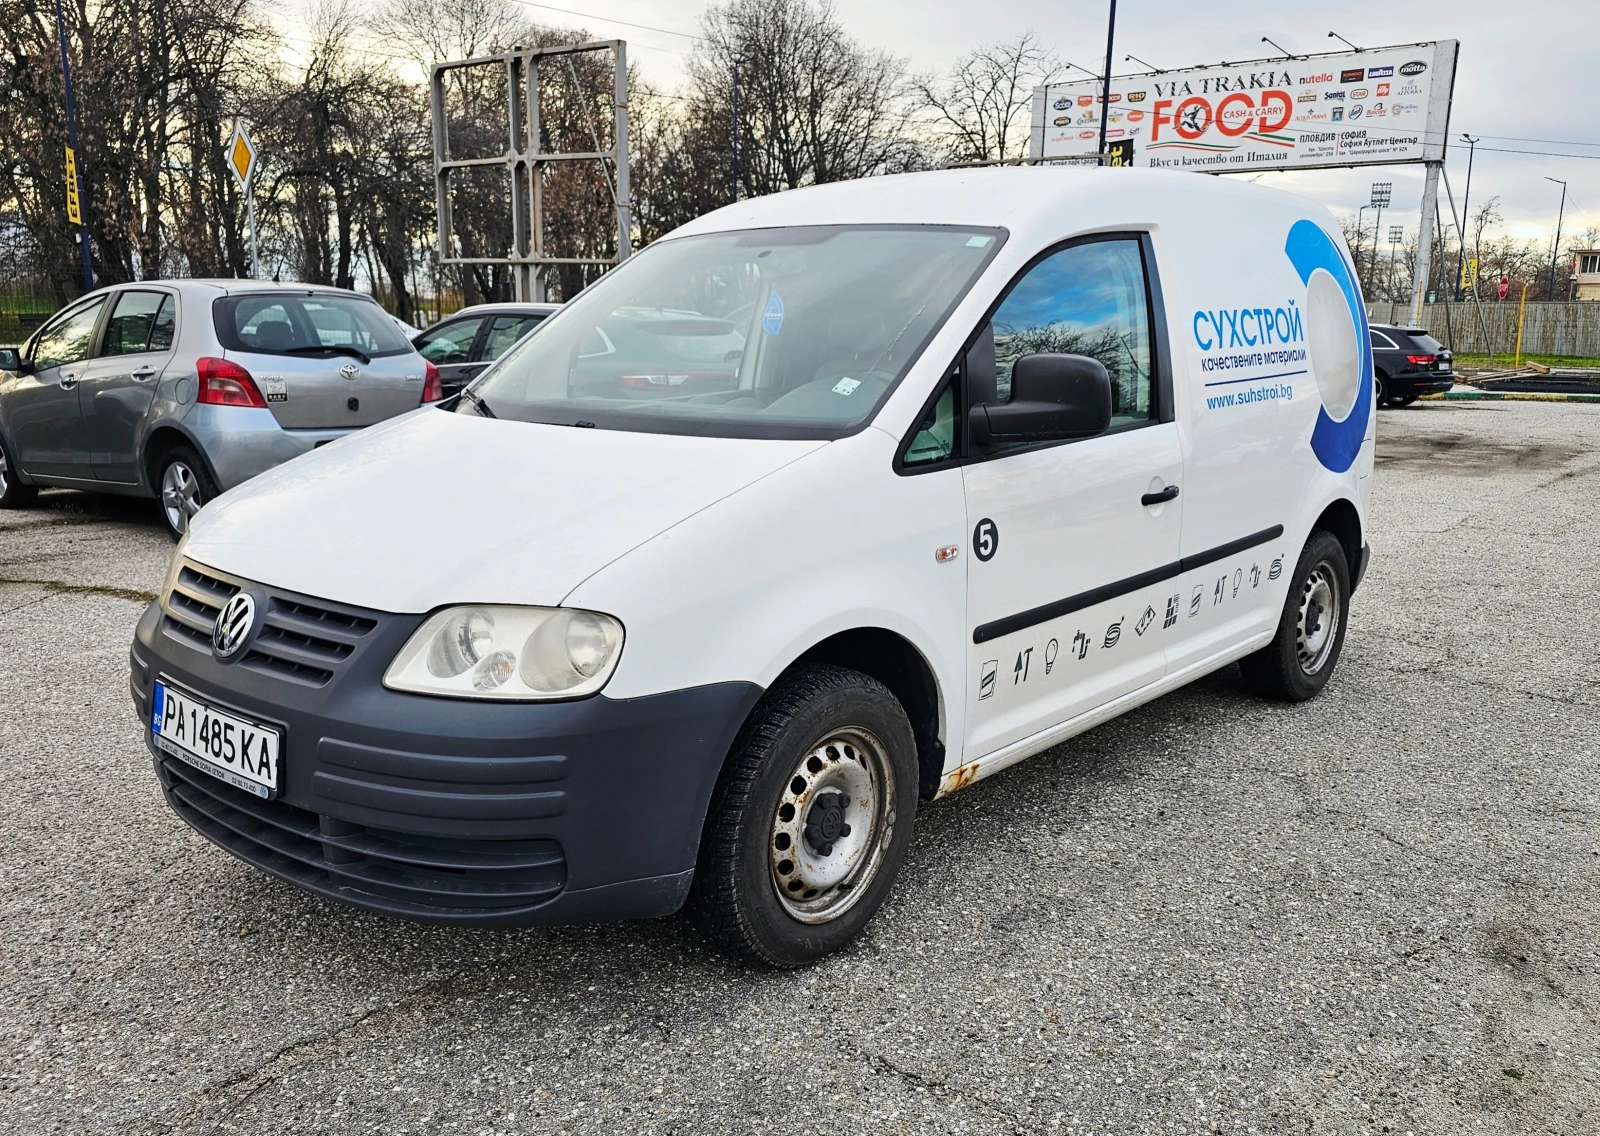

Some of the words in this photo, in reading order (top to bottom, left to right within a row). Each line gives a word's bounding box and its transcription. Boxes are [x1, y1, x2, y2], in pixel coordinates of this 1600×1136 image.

[1154, 80, 1193, 98] VIA
[1199, 70, 1294, 94] TRAKIA
[1299, 73, 1333, 85] nutella
[1151, 90, 1293, 142] FOOD
[1224, 109, 1246, 119] CASH
[1255, 106, 1284, 116] CARRY
[1300, 132, 1336, 144] ПЛОВДИВ
[1340, 140, 1362, 149] София
[1363, 138, 1388, 147] Аутлет
[1389, 136, 1418, 145] Център
[1341, 130, 1367, 140] СОФИЯ
[1150, 157, 1171, 168] Вкус
[1182, 153, 1227, 166] качество
[1229, 154, 1244, 163] от
[1247, 151, 1288, 162] Италия
[1193, 299, 1304, 351] СУХСТРОЙ
[1201, 353, 1263, 372] качествените
[1264, 349, 1307, 366] материали
[1207, 384, 1293, 410] www.suhstroi.bg
[979, 523, 993, 556] 5
